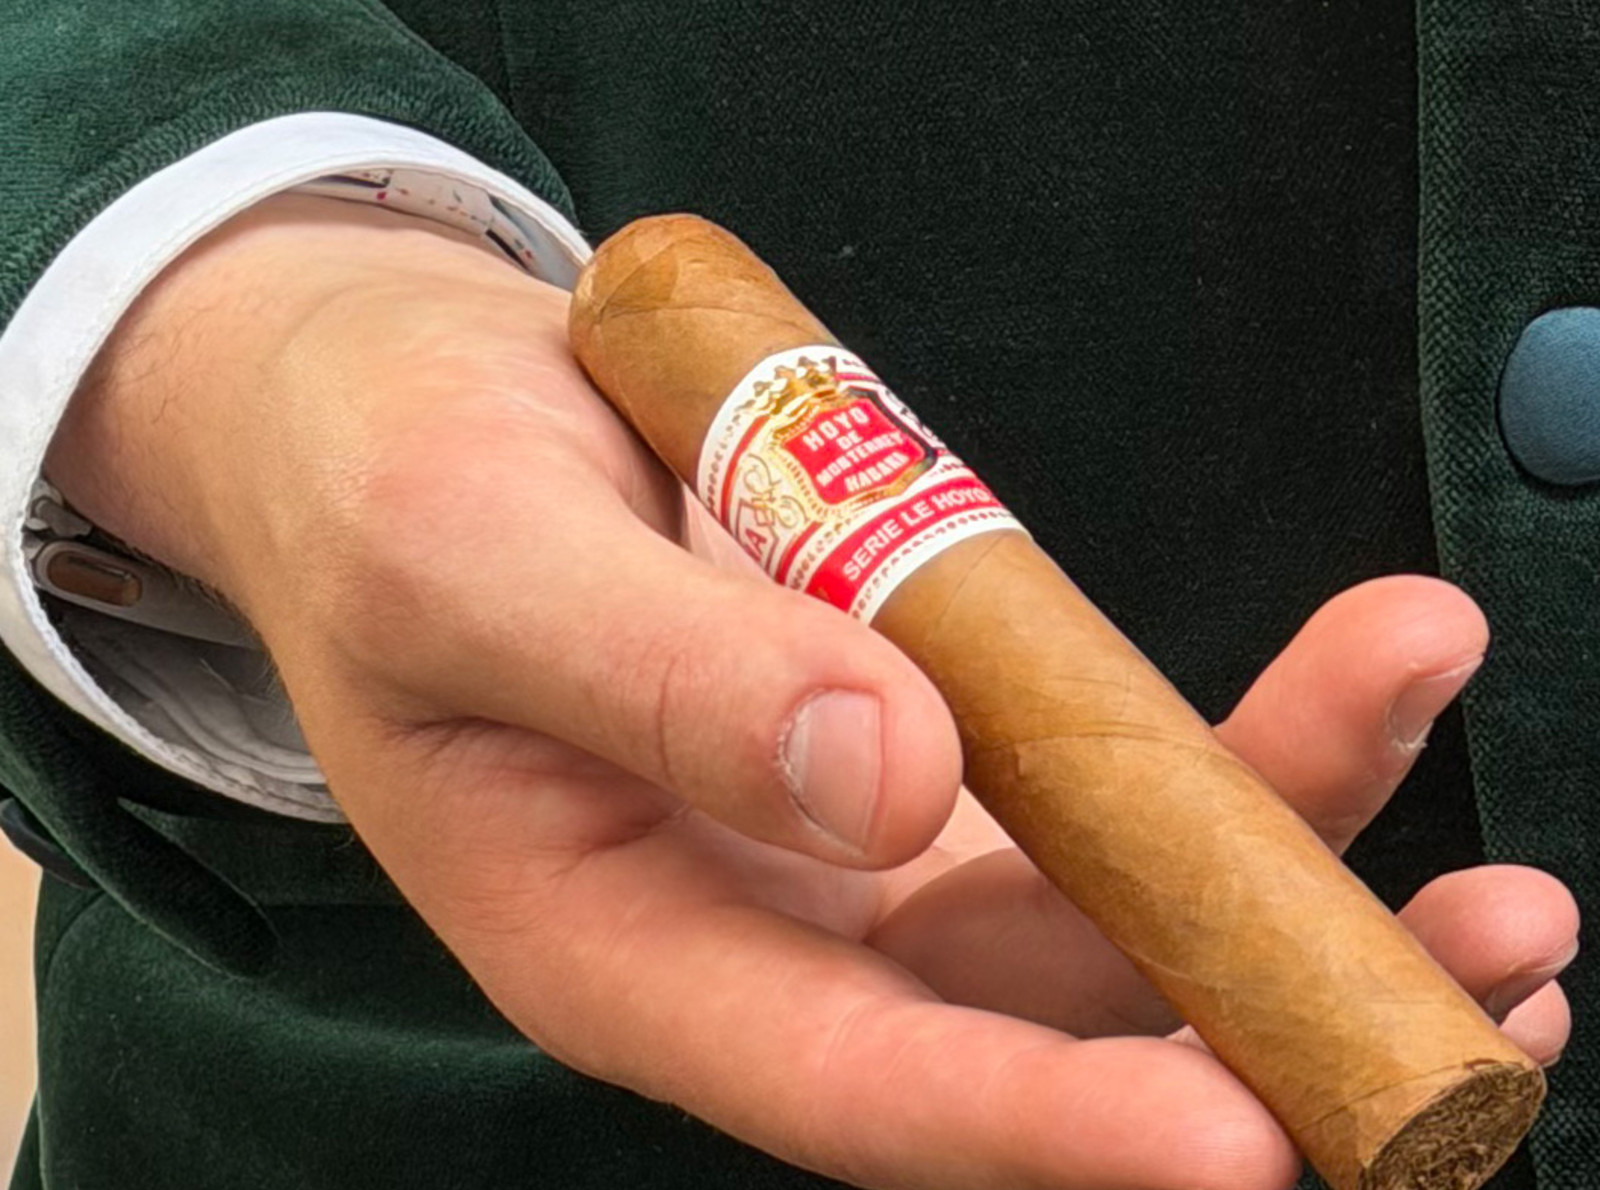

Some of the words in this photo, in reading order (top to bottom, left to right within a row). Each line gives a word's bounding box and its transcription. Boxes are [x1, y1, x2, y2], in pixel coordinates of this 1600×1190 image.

[802, 406, 869, 451] HOYO
[836, 430, 863, 450] DE
[816, 431, 903, 487] MONTERREY
[843, 519, 904, 580] SERIE
[900, 500, 935, 526] LE
[931, 487, 991, 510] HOYO
